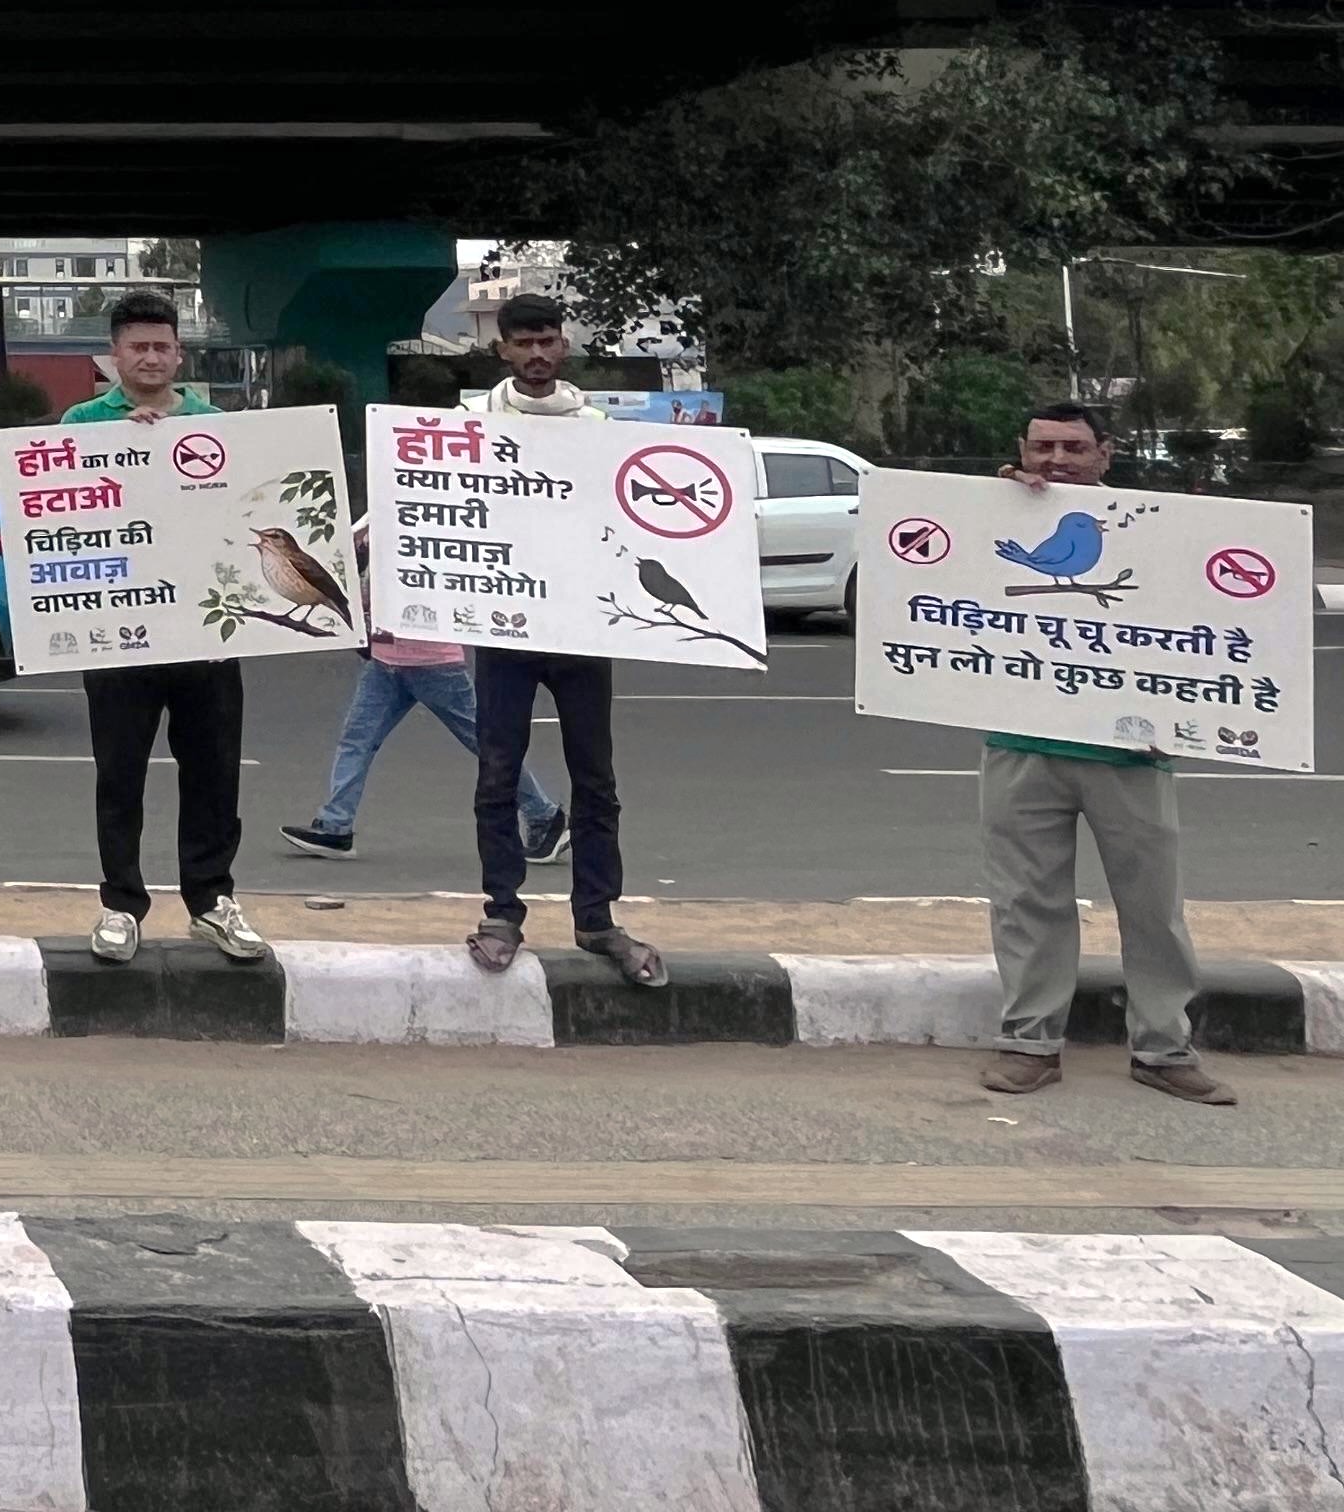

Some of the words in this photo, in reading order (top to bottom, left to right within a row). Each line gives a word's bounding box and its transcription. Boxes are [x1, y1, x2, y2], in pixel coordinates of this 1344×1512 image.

[15, 438, 77, 477] हॉर्न
[80, 454, 109, 469] का
[114, 447, 151, 468] शोर
[392, 417, 486, 464] हॉर्न
[491, 435, 521, 463] से
[19, 476, 124, 519] हटाओ
[394, 468, 452, 491] क्या
[457, 471, 574, 500] पाओगे?
[395, 498, 489, 529] हमारी
[24, 526, 112, 556] चिड़िया
[117, 520, 153, 546] की
[397, 535, 513, 570] आवाज़
[30, 555, 129, 584] आवाज़
[397, 564, 437, 590] खो
[32, 590, 103, 615] वापस
[109, 579, 176, 608] लाओ
[909, 595, 1028, 636] चिड़िया
[1035, 614, 1073, 650] चू
[1074, 619, 1112, 654] चू
[1114, 623, 1216, 656] करती
[1223, 627, 1254, 664] है
[882, 641, 941, 675] सुन
[949, 645, 994, 675] लो
[1003, 650, 1044, 680] वो
[1053, 659, 1125, 695] कुछ
[1135, 671, 1244, 706] कहती
[1251, 677, 1281, 713] है
